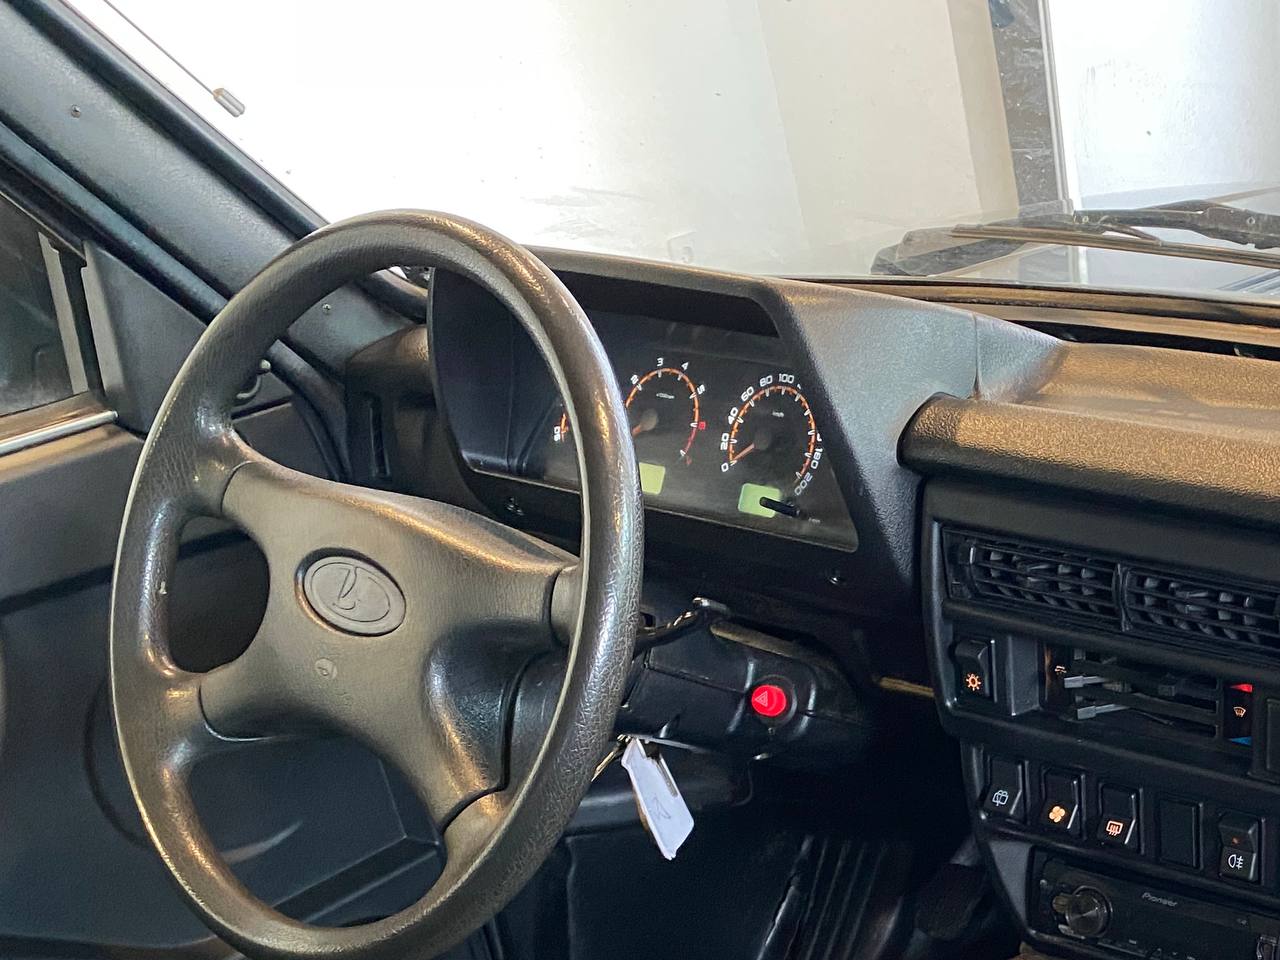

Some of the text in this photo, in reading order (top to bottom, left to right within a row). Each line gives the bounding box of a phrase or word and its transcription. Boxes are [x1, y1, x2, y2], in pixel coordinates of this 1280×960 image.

[657, 358, 664, 366] 3
[681, 362, 689, 371] 4
[630, 374, 639, 385] 2
[759, 375, 773, 387] 80
[778, 373, 795, 384] 100
[696, 384, 705, 395] 5
[741, 386, 754, 402] 60
[727, 407, 739, 425] 40
[720, 433, 730, 450] 20
[721, 463, 729, 472] 0
[794, 472, 813, 496] 200
